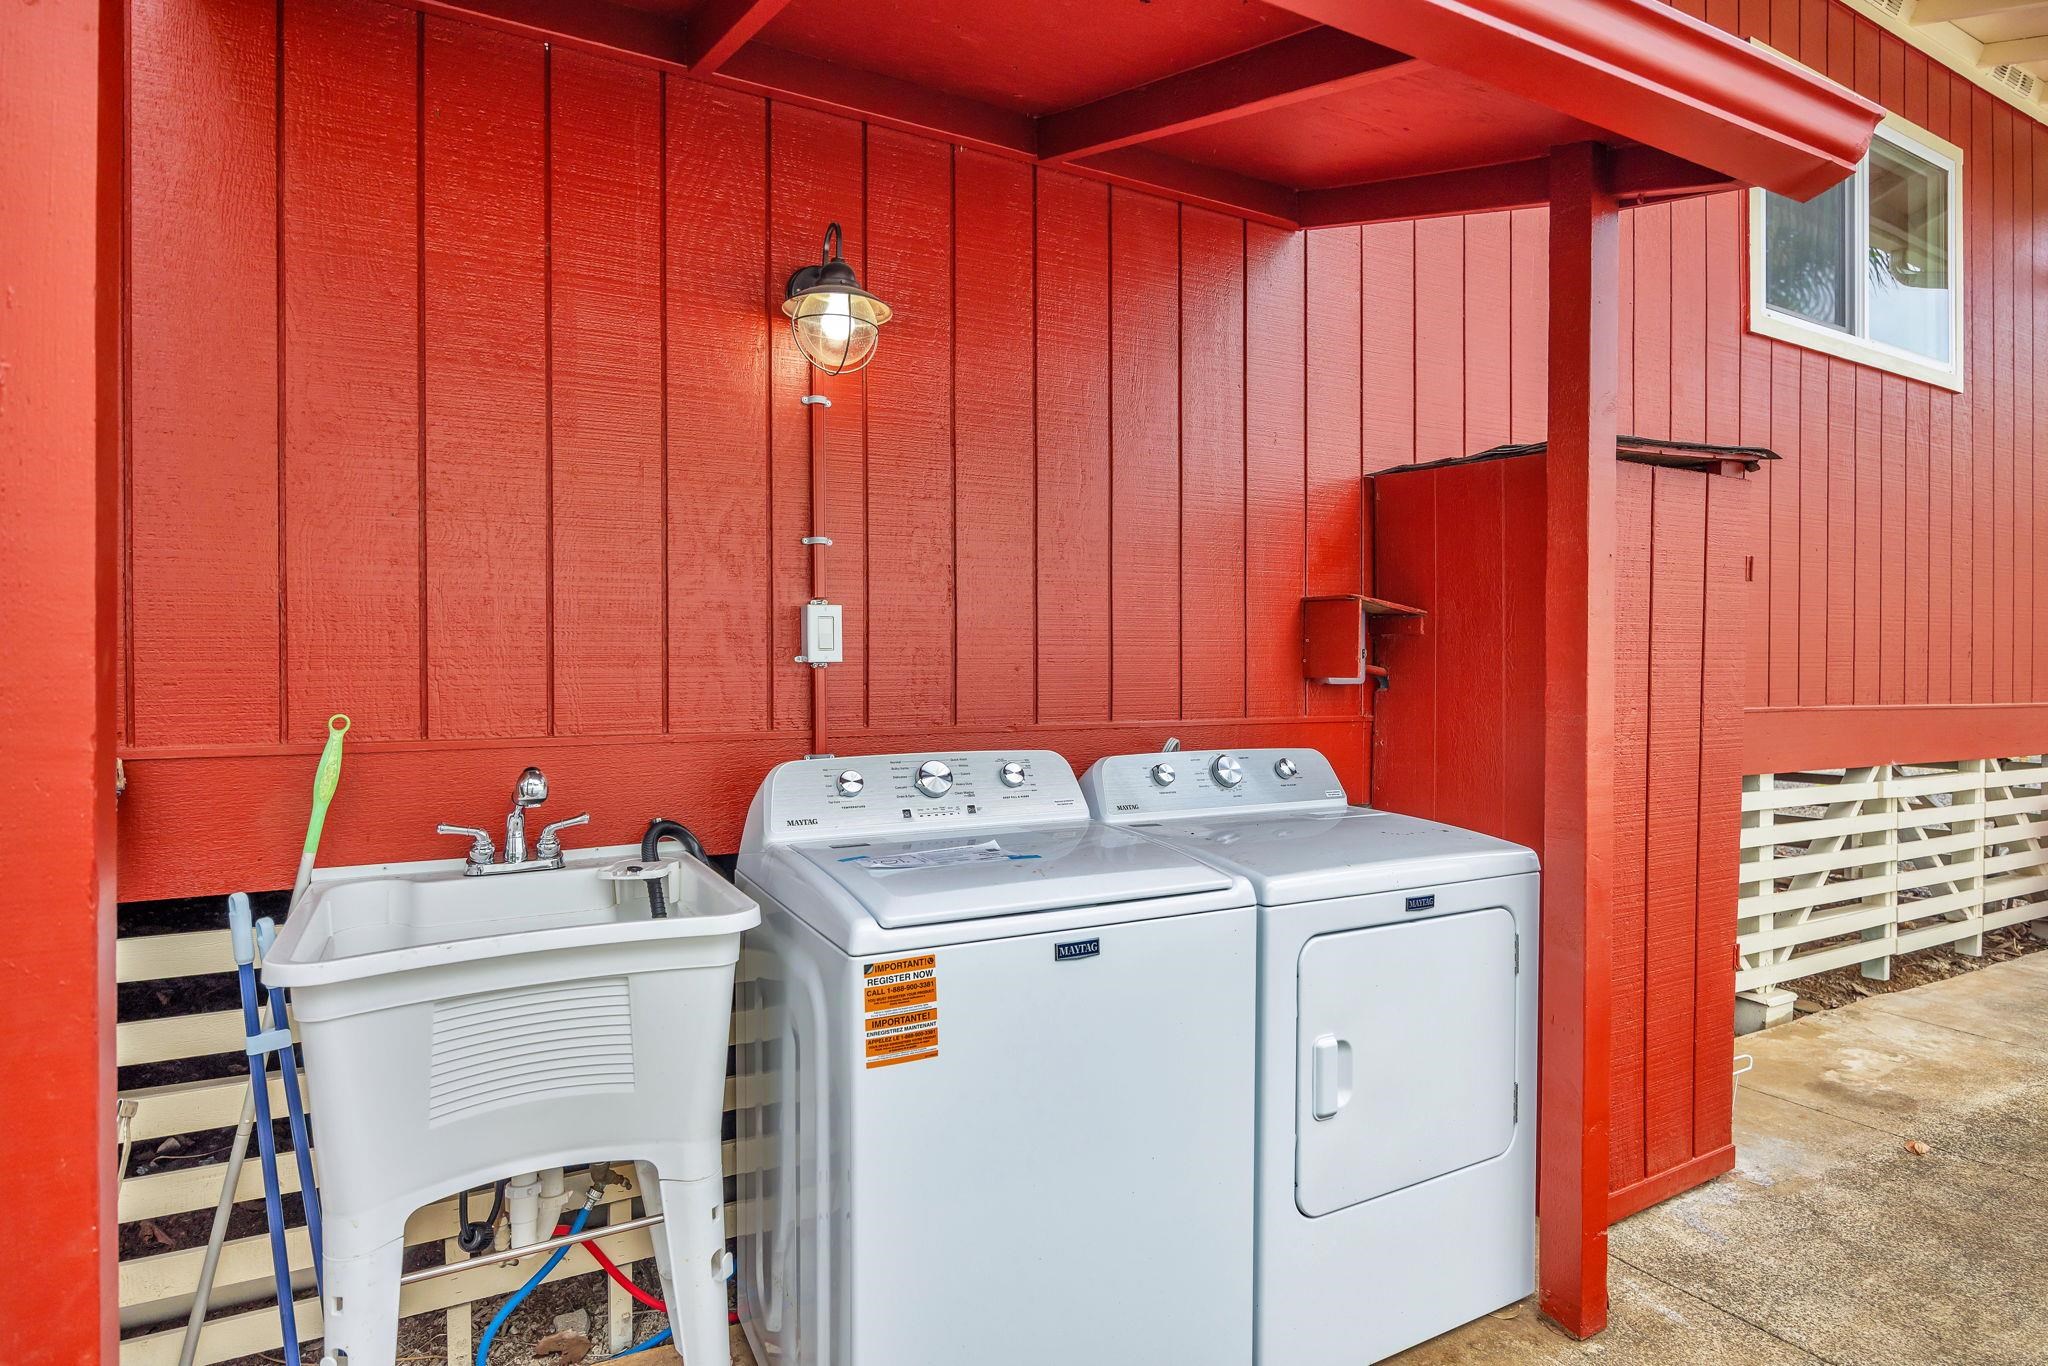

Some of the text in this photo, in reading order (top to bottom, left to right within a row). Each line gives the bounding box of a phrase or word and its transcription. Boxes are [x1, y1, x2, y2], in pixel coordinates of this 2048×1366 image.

[786, 818, 818, 826] MAYTAG
[1408, 897, 1434, 908] MAYTAG
[1059, 942, 1098, 957] MAYTAG
[874, 958, 927, 973] IMPORTANT!
[867, 969, 934, 987] REGISTER NOW
[866, 988, 885, 997] CALL
[871, 1011, 931, 1029] IMPORTANTE!
[866, 1021, 937, 1038] ENREGISTREZ MAINTENANT
[867, 1037, 893, 1046] APPELEZ
